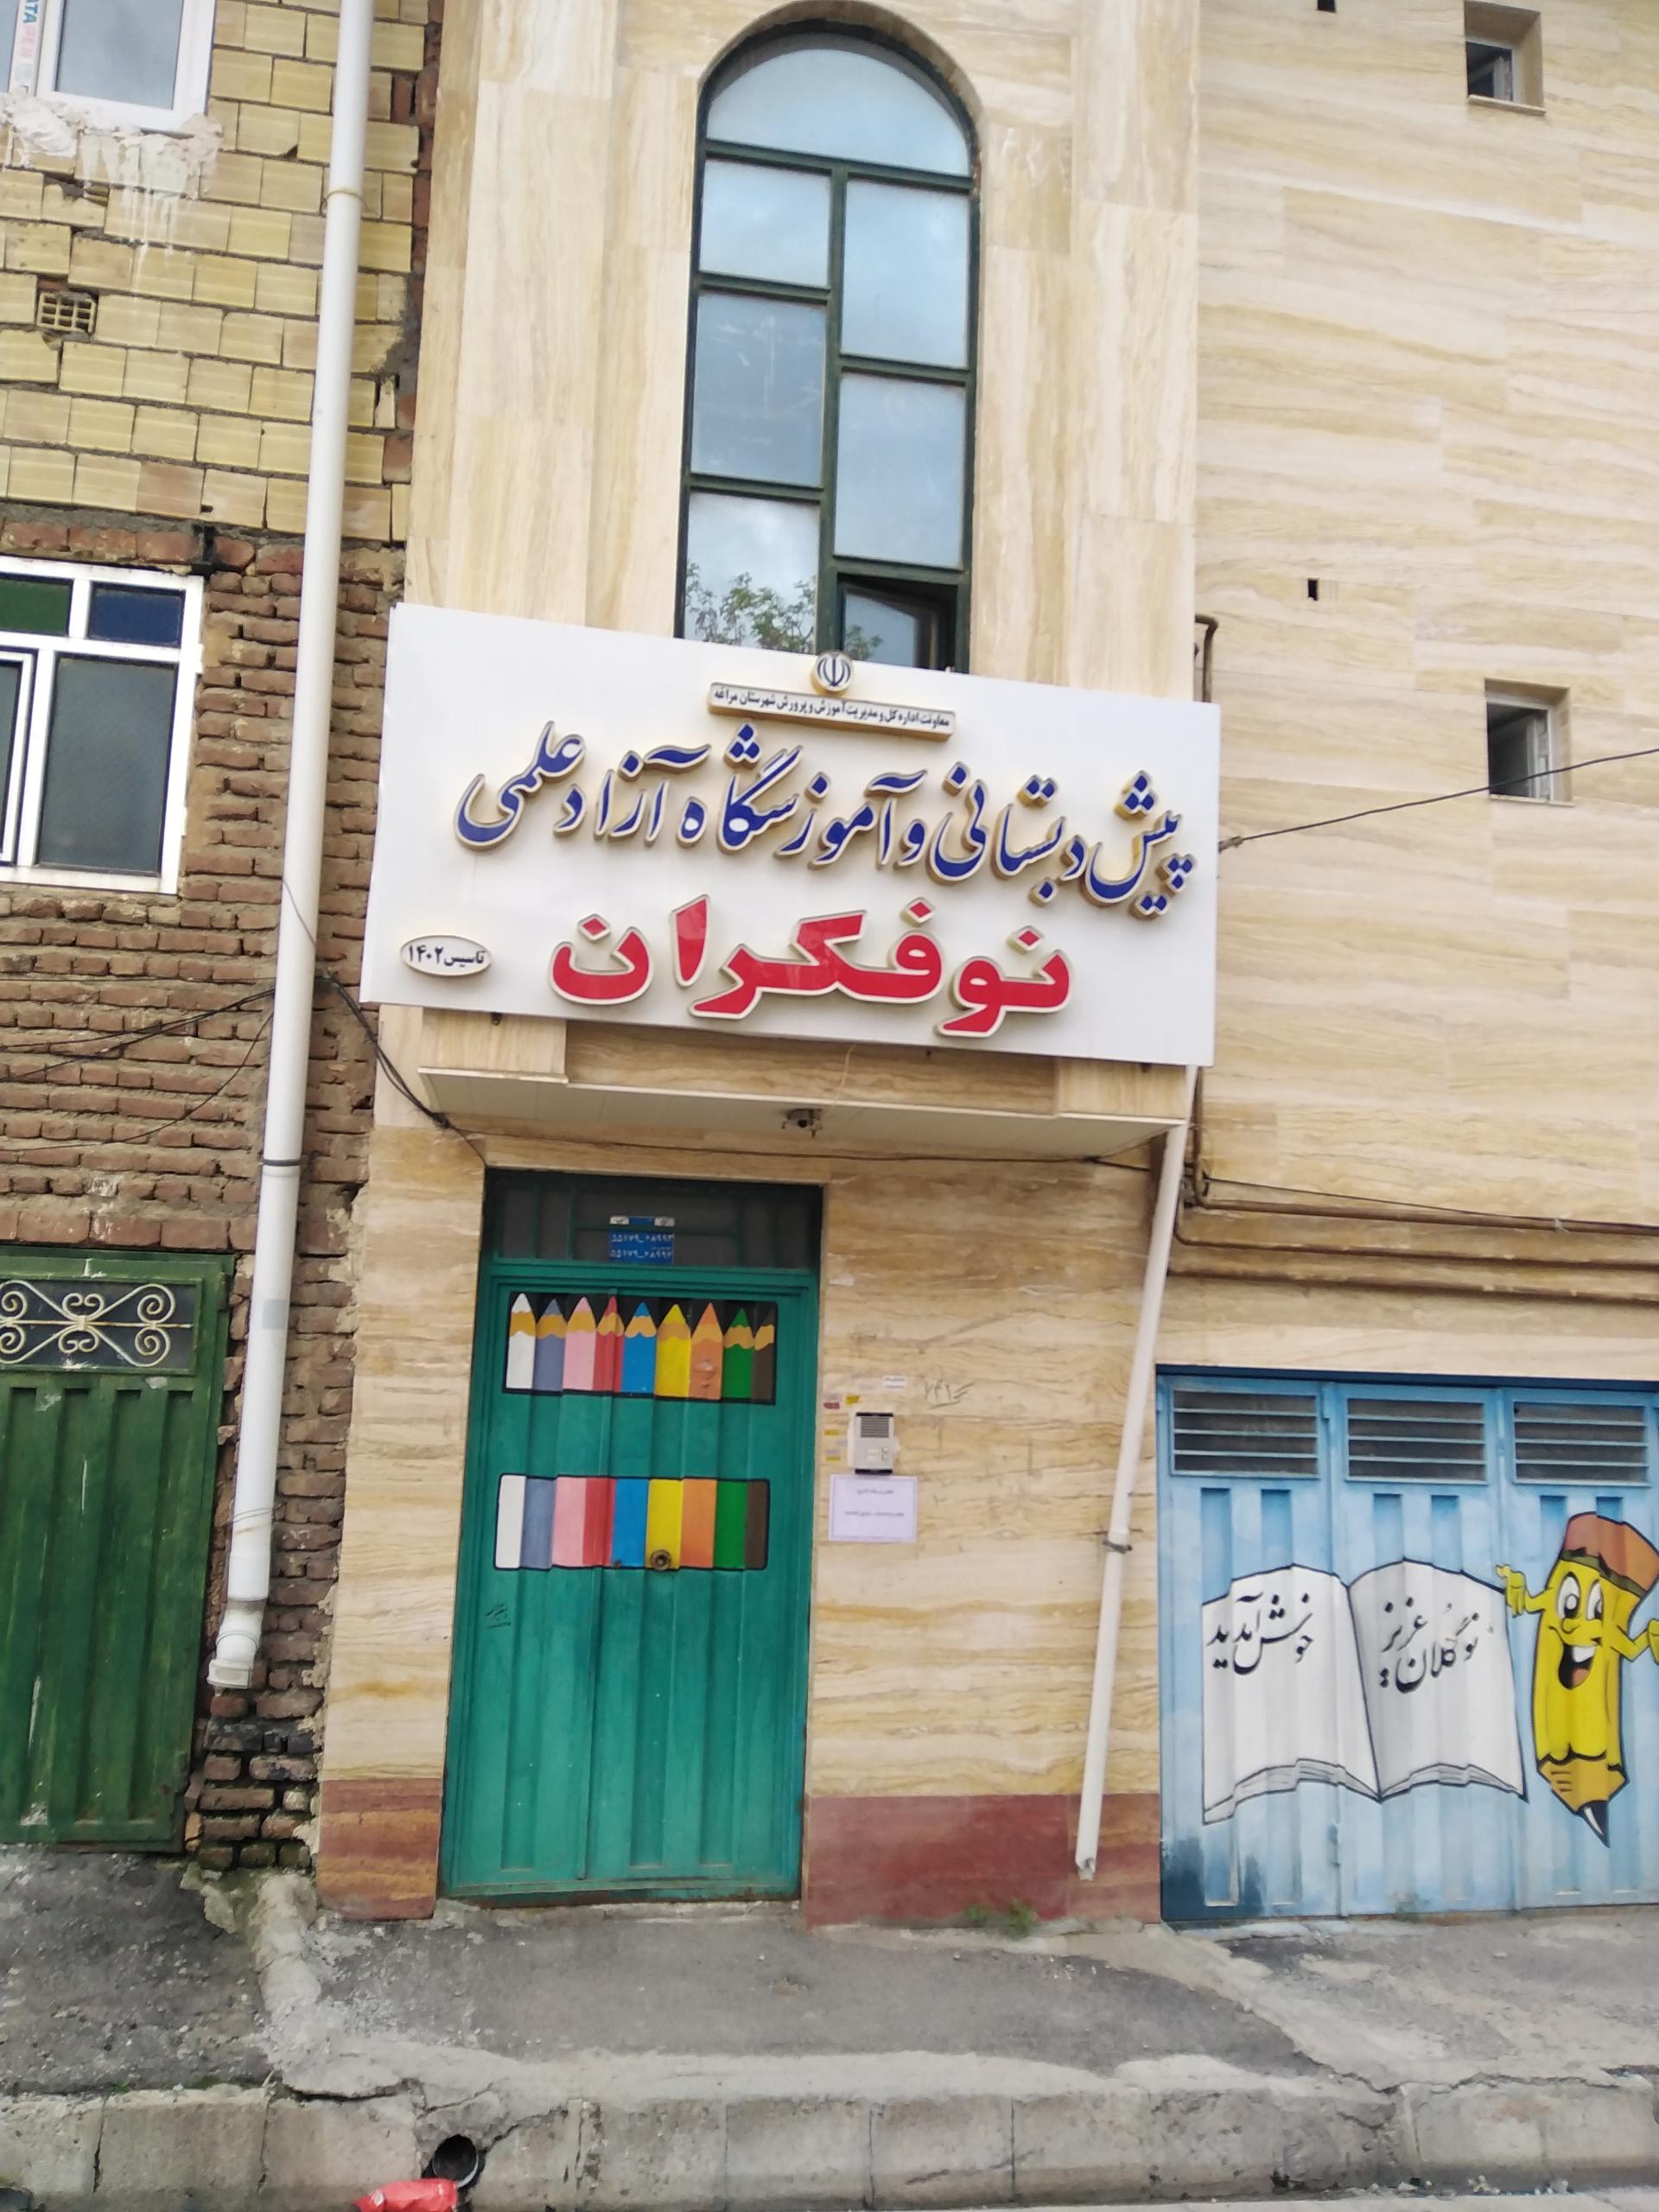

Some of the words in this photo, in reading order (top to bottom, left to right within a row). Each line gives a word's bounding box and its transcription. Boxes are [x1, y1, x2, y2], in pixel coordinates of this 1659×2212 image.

[714, 686, 738, 705] مراغه
[739, 690, 776, 709] شهرستان
[815, 698, 847, 717] آموزش
[846, 704, 879, 721] مدیریت
[899, 709, 919, 726] اداره
[452, 719, 587, 853] علمی
[552, 743, 711, 847] آزاد
[676, 720, 930, 869] آموزشگاه
[893, 817, 929, 868] و
[409, 944, 443, 964] ۱۴۰۲
[1205, 1591, 1264, 1669] آمدید
[1232, 1592, 1314, 1675] خوش
